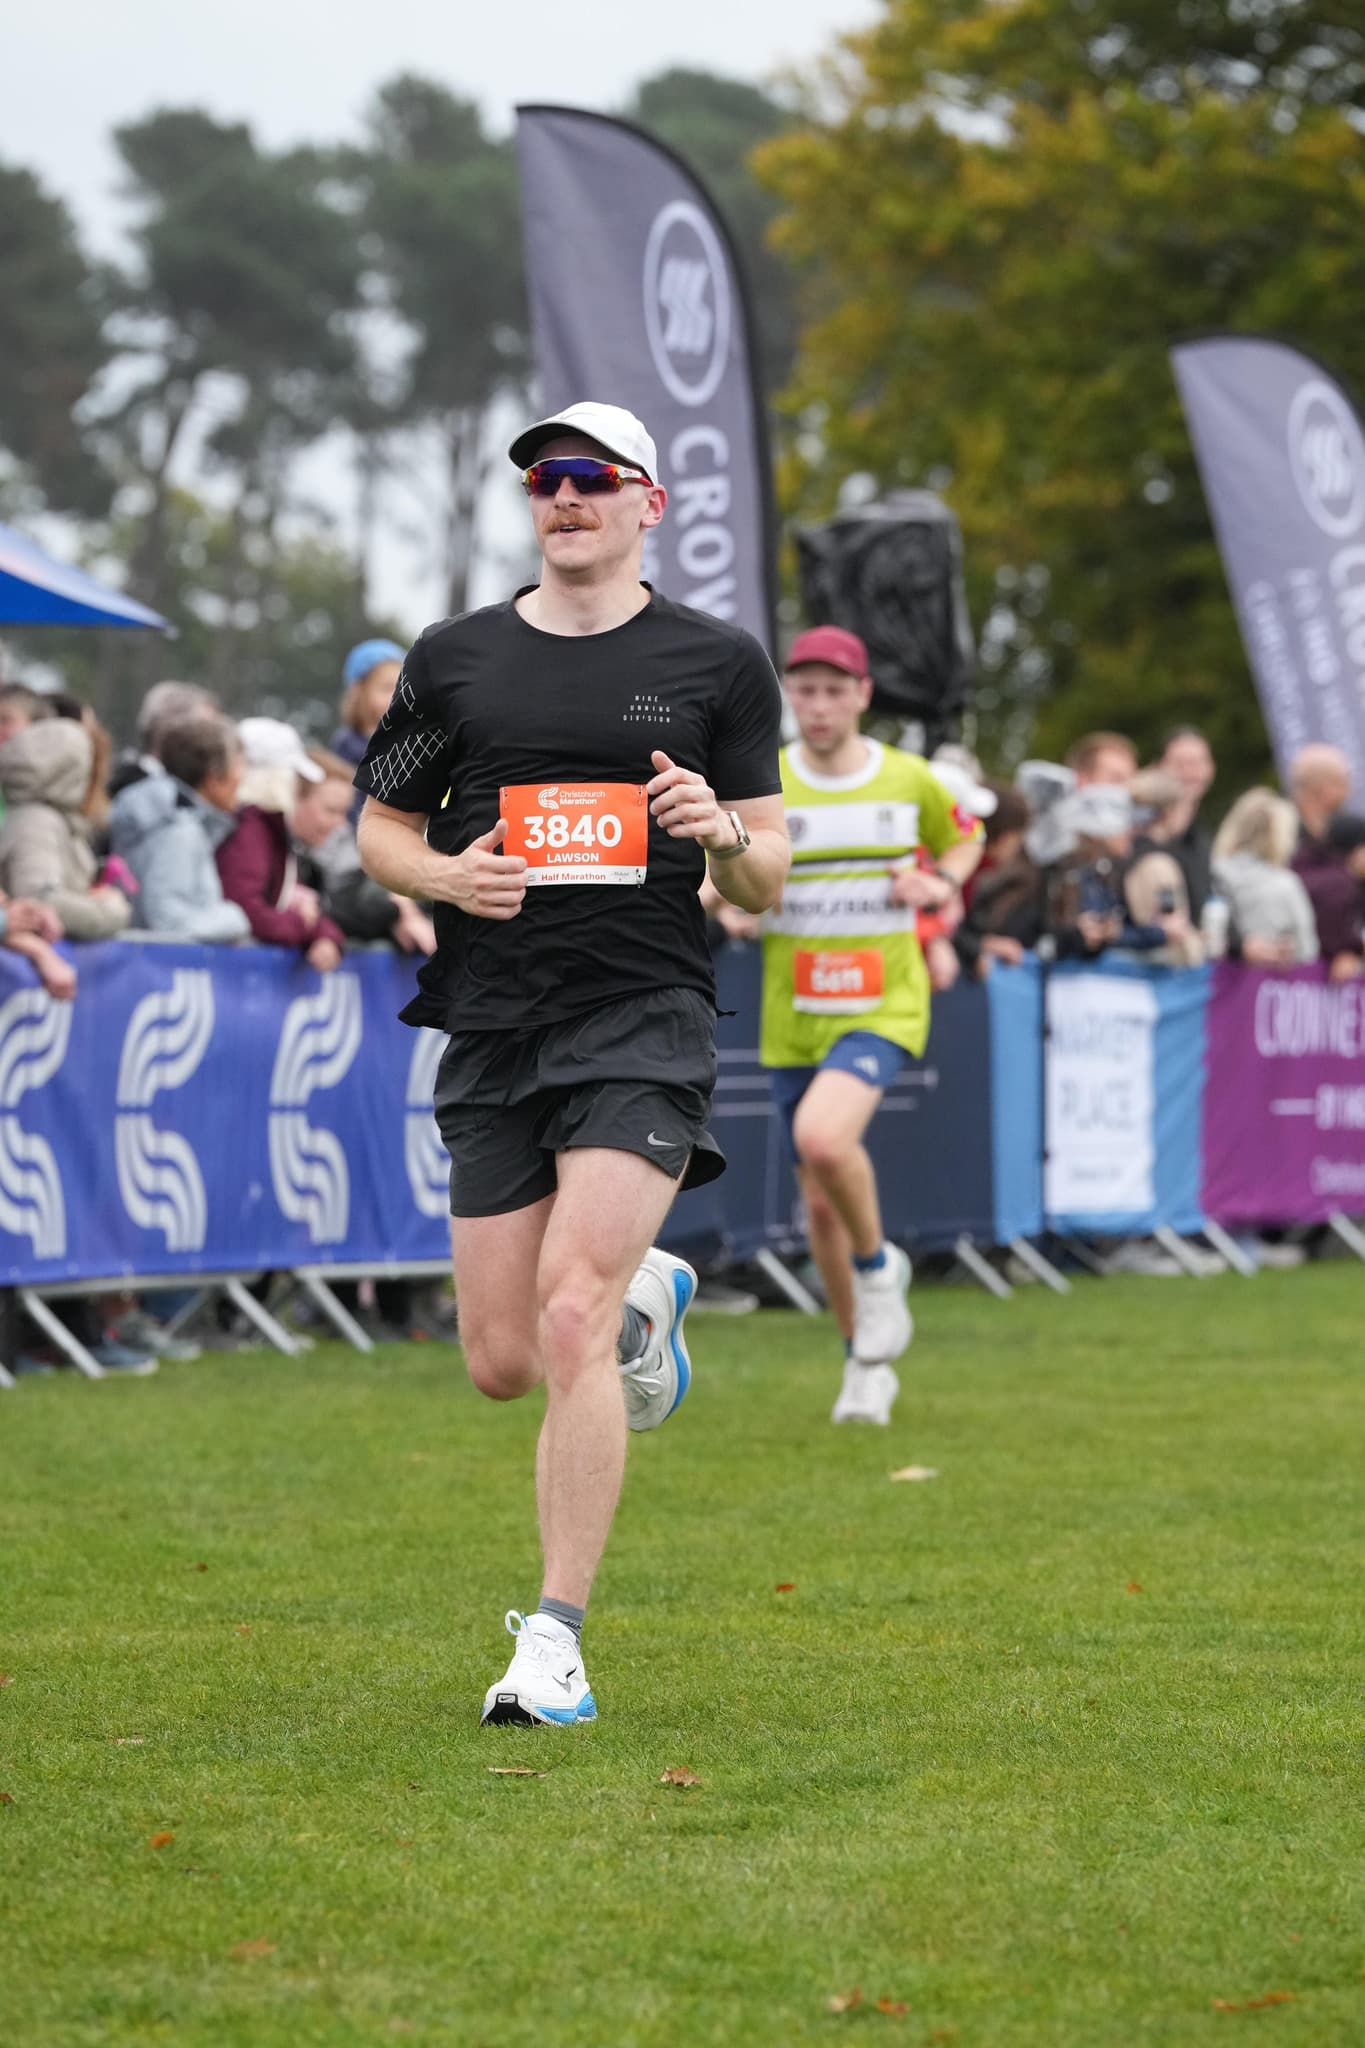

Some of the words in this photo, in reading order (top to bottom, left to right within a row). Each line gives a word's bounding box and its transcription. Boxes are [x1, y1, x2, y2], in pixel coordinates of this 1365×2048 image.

[559, 790, 606, 798] Christchurch
[523, 814, 623, 849] 3840
[546, 852, 600, 863] LAWSON
[541, 873, 560, 881] Half
[561, 872, 607, 881] Marathon
